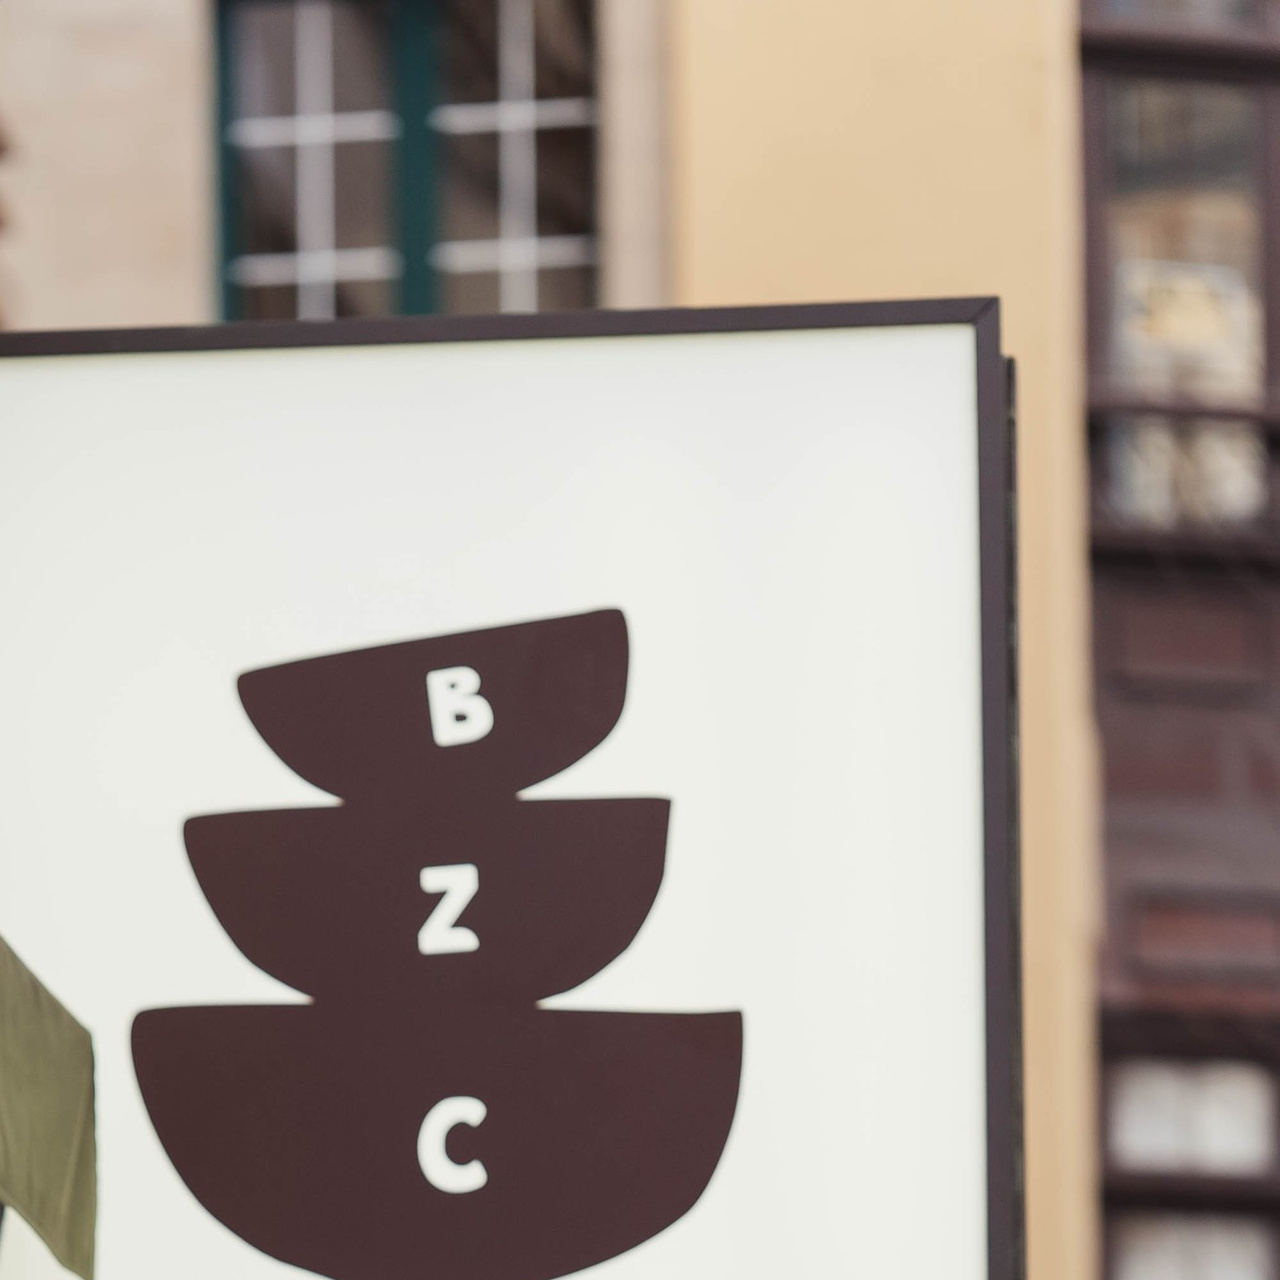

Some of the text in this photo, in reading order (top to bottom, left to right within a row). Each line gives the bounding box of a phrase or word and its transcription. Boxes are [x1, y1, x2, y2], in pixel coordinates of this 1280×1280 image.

[425, 665, 495, 748] B
[416, 862, 481, 956] Z
[416, 1095, 489, 1194] C
